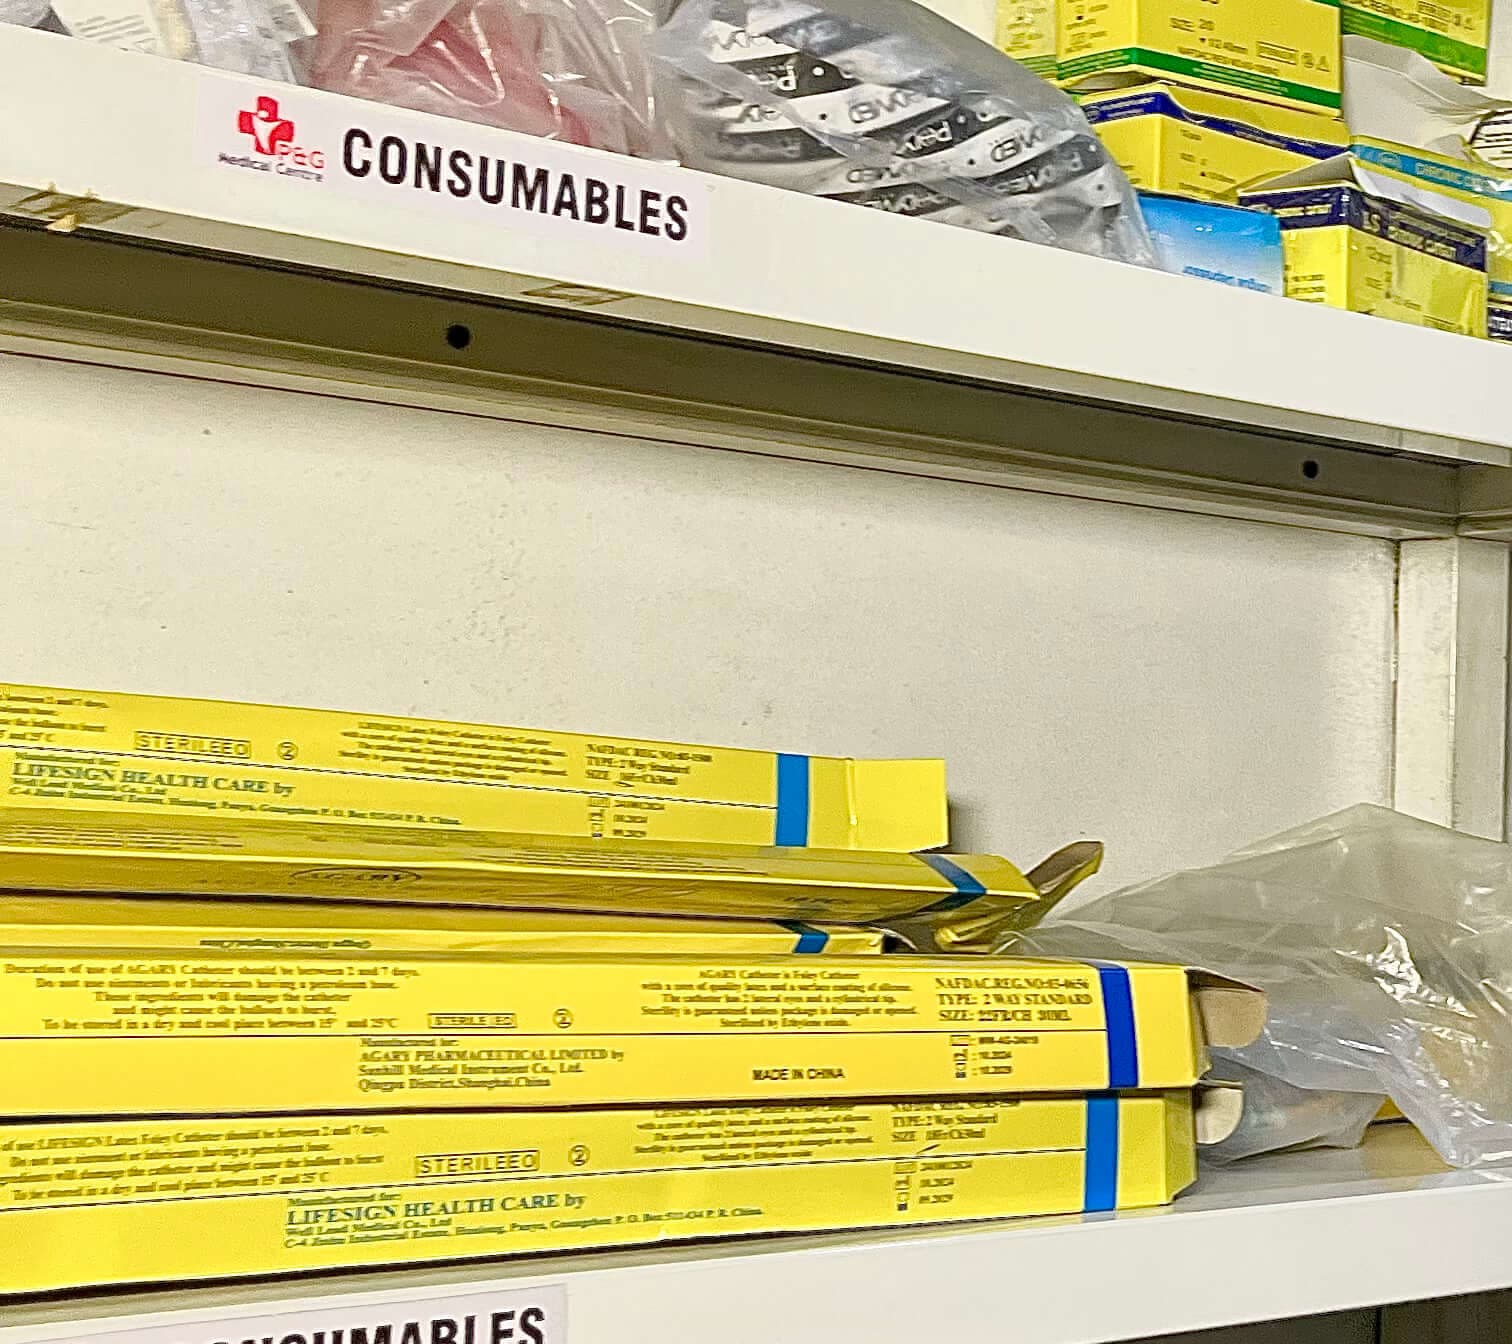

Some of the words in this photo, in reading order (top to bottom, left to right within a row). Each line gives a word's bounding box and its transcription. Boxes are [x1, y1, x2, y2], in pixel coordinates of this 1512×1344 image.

[217, 150, 272, 174] Medical
[275, 162, 326, 184] Centre
[341, 127, 690, 243] CONSUMABLES
[13, 762, 117, 782] LIFESIGN
[122, 769, 209, 789] HEALTH
[213, 776, 269, 794] CARE
[273, 781, 296, 798] by
[752, 1068, 790, 1081] MADE
[792, 1068, 804, 1080] IN
[807, 1067, 845, 1080] CHINA
[286, 1204, 397, 1226] LIFESIGN
[403, 1197, 495, 1218] HEALTH
[499, 1194, 560, 1212] CARE
[564, 1192, 586, 1210] by
